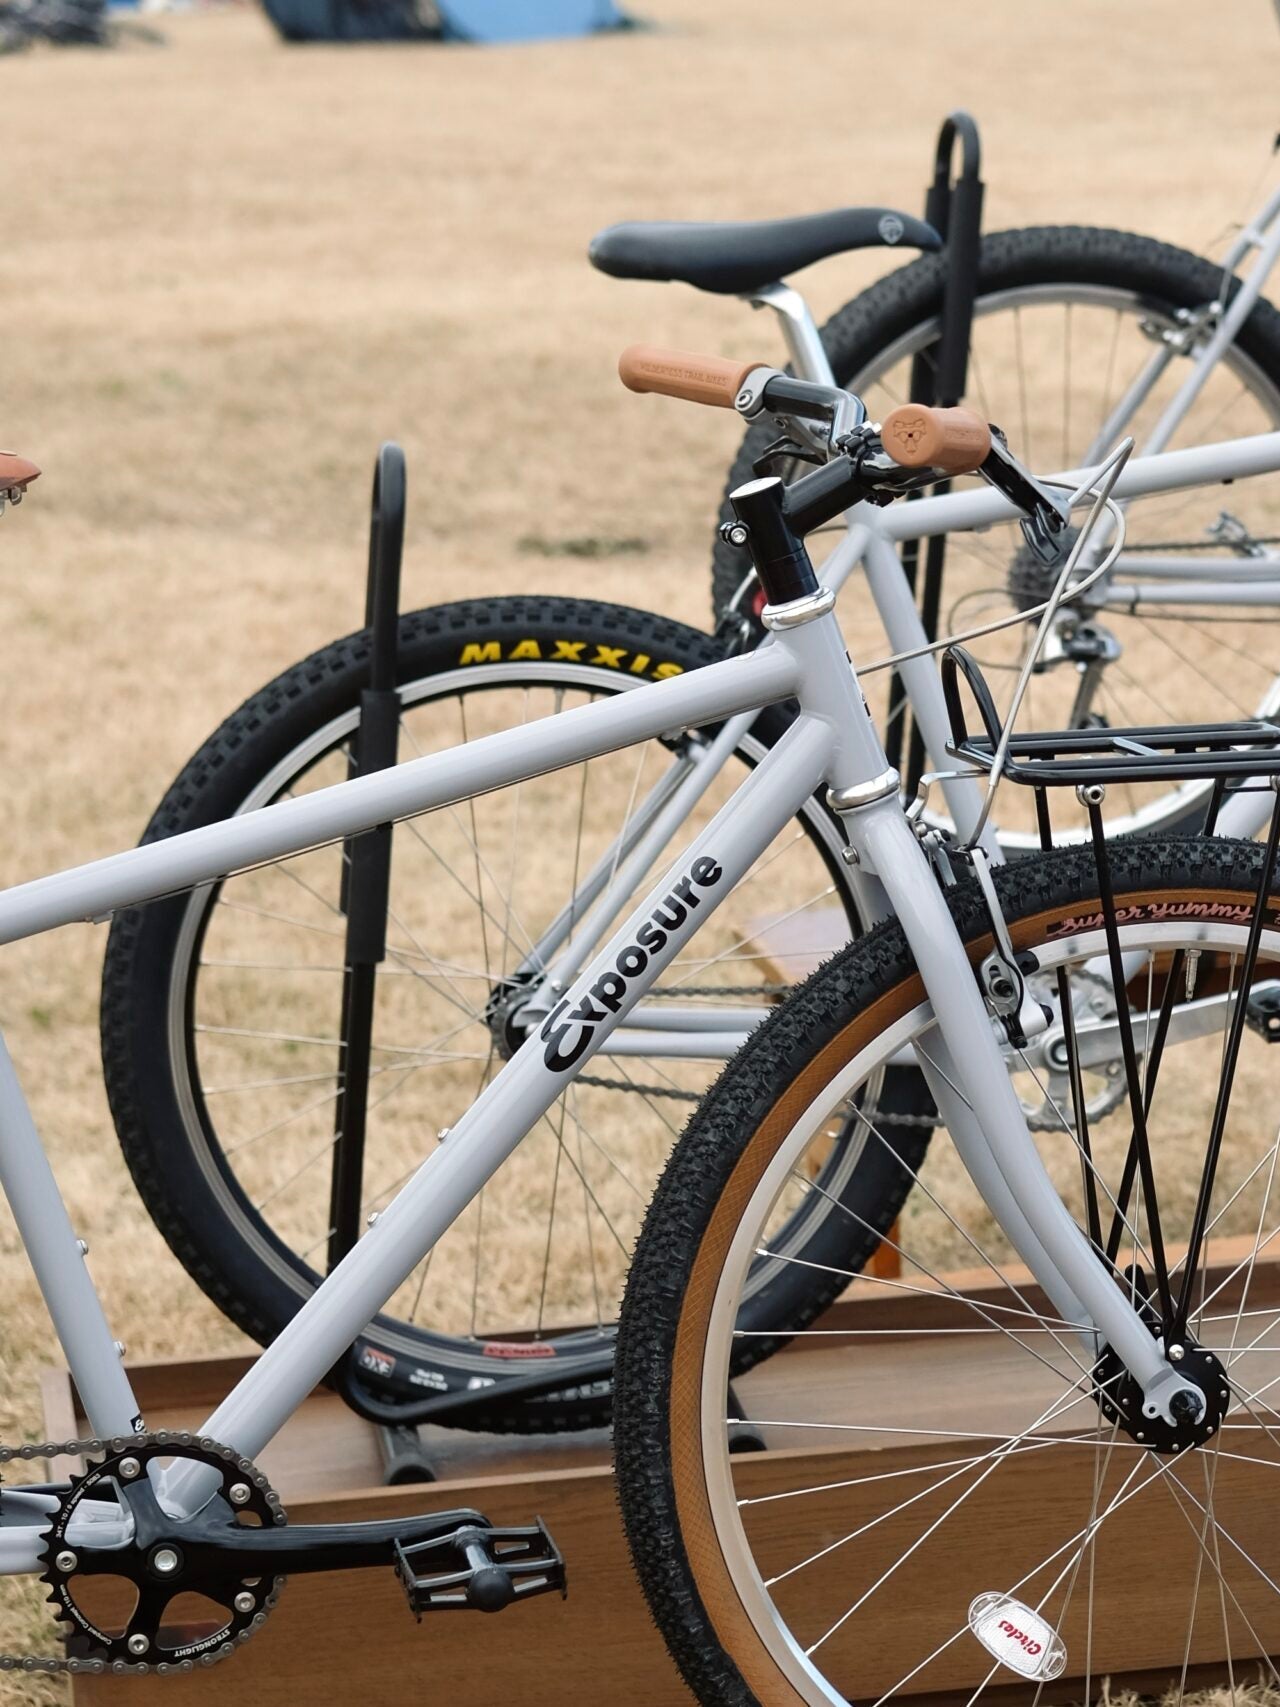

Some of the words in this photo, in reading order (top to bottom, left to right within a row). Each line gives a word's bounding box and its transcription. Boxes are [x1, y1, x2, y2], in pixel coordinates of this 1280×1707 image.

[459, 639, 685, 681] MAXXIS
[540, 855, 723, 1073] Exposure
[174, 1628, 231, 1658] STRONGLIGHT
